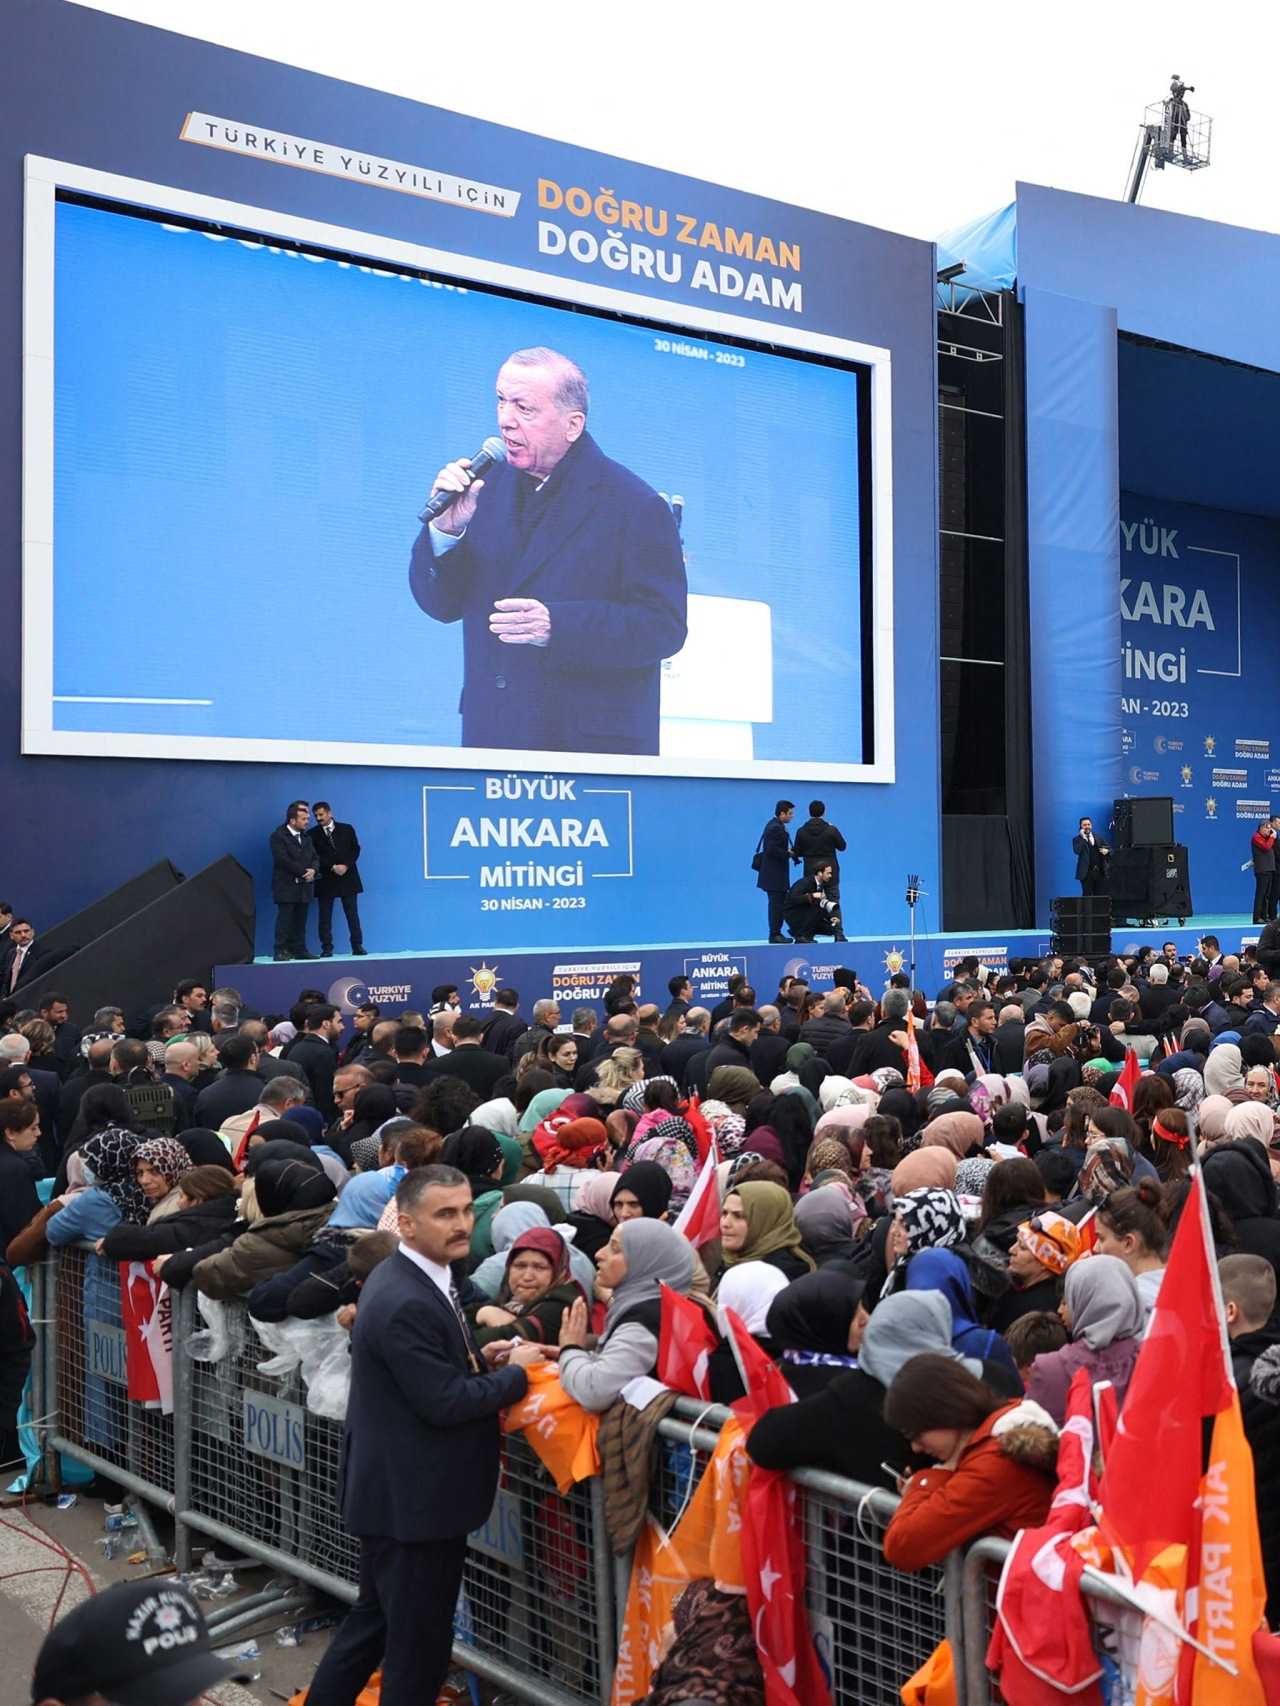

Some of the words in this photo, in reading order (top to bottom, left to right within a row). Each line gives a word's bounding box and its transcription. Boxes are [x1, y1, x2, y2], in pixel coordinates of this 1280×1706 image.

[205, 122, 325, 165] TÜRKİYE
[341, 155, 443, 194] YÜZYILI
[457, 184, 506, 210] İÇİN
[538, 178, 668, 237] DOĞRU
[676, 214, 801, 272] ZAMAN
[538, 221, 682, 283] DOĞRU
[690, 260, 803, 313] ADAM
[654, 338, 671, 352] 30
[671, 341, 709, 360] NİSAN
[715, 350, 746, 368] 2023
[1120, 517, 1179, 559] YÜK
[1120, 578, 1215, 631] KARA
[1121, 640, 1187, 683] İNGİ
[1152, 700, 1189, 718] 2023
[1254, 752, 1270, 760] ADAM
[485, 773, 576, 801] BÜYÜK
[1231, 781, 1248, 789] ADAM
[450, 816, 610, 847] ANKARA
[479, 860, 584, 888] MİTİNGİ
[480, 899, 499, 911] 30
[501, 896, 543, 911] NİSAN
[552, 897, 586, 909] 2023
[701, 952, 729, 963] BÜYÜK
[978, 956, 1007, 966] AMAN
[552, 973, 595, 987] DOĞRU
[597, 973, 641, 985] ZAN
[692, 966, 740, 978] ANKARA
[700, 980, 729, 990] MİTİNG
[552, 986, 600, 1001] DOĞRU
[247, 1403, 303, 1464] POLİS
[471, 1496, 522, 1558] LİS
